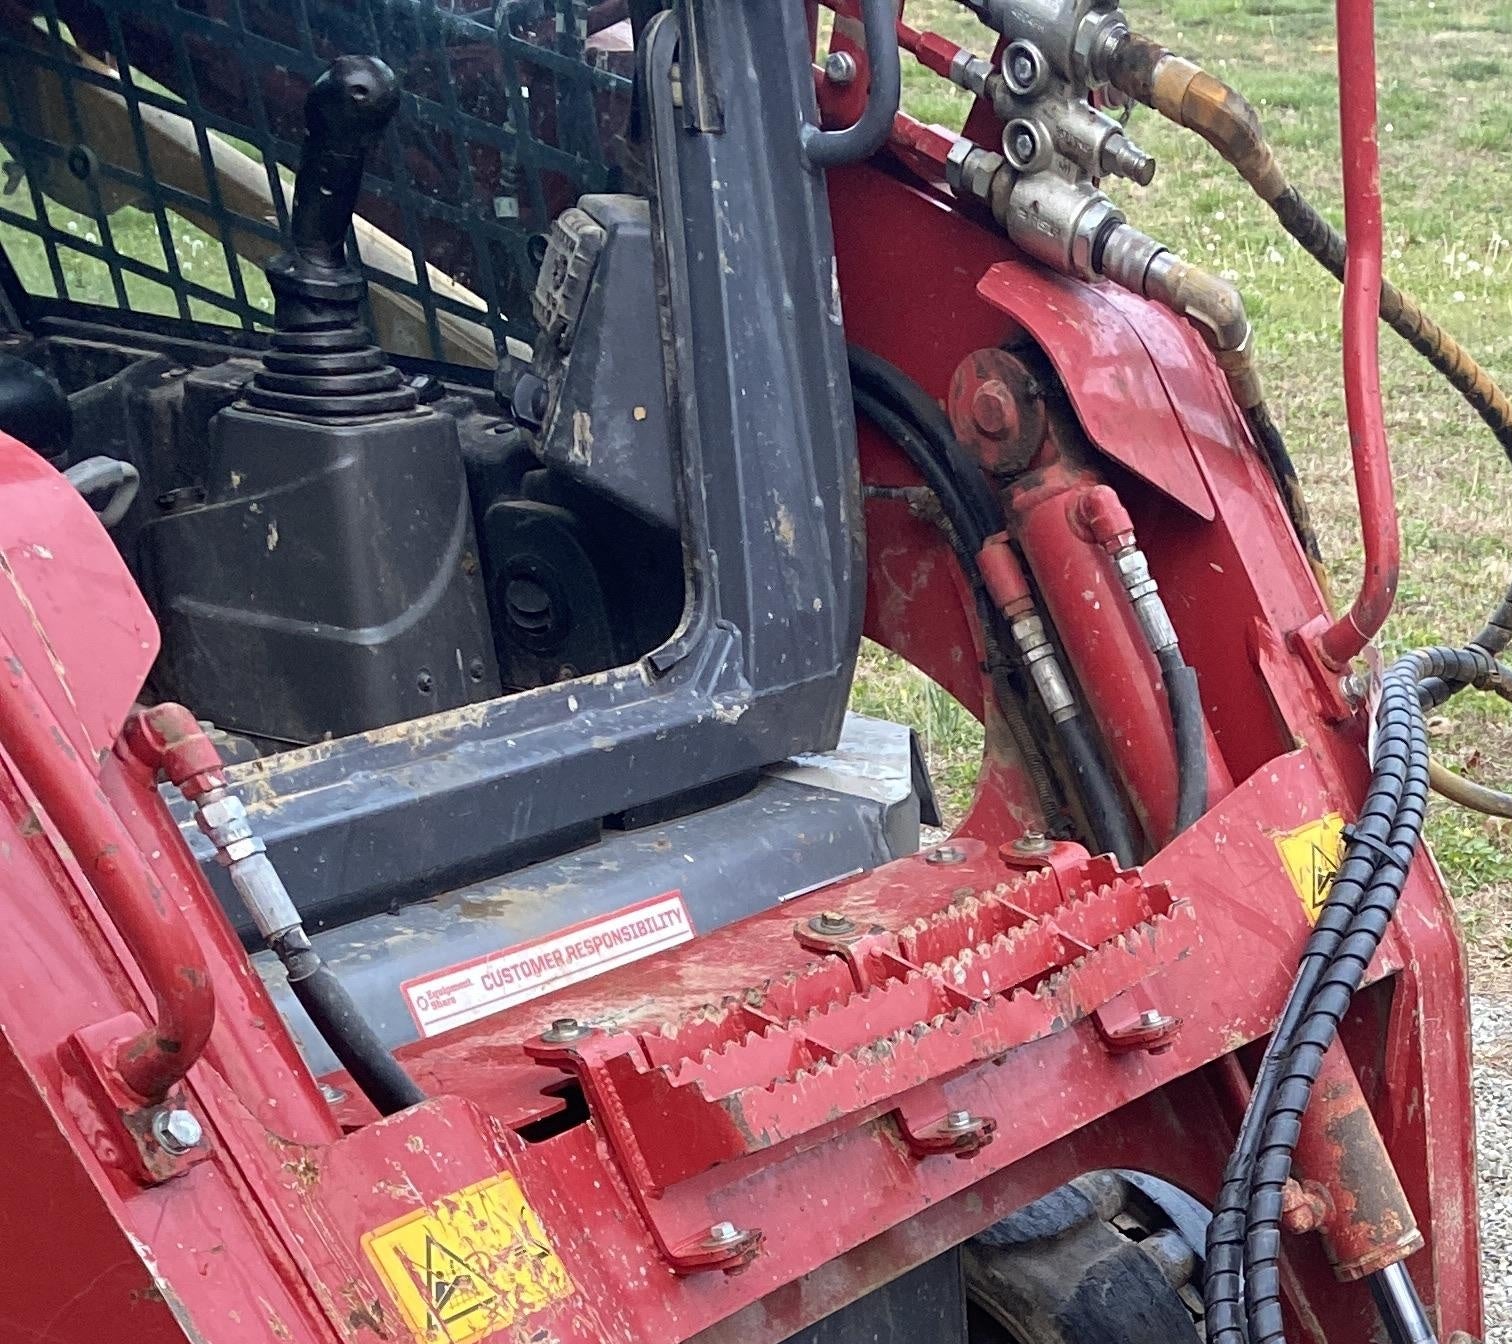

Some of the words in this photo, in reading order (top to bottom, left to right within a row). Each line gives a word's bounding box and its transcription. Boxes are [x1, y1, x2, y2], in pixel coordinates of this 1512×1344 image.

[481, 949, 565, 992] CUSTOMER
[566, 908, 684, 963] RESPONSIBILITY
[426, 978, 474, 1000] Equipment
